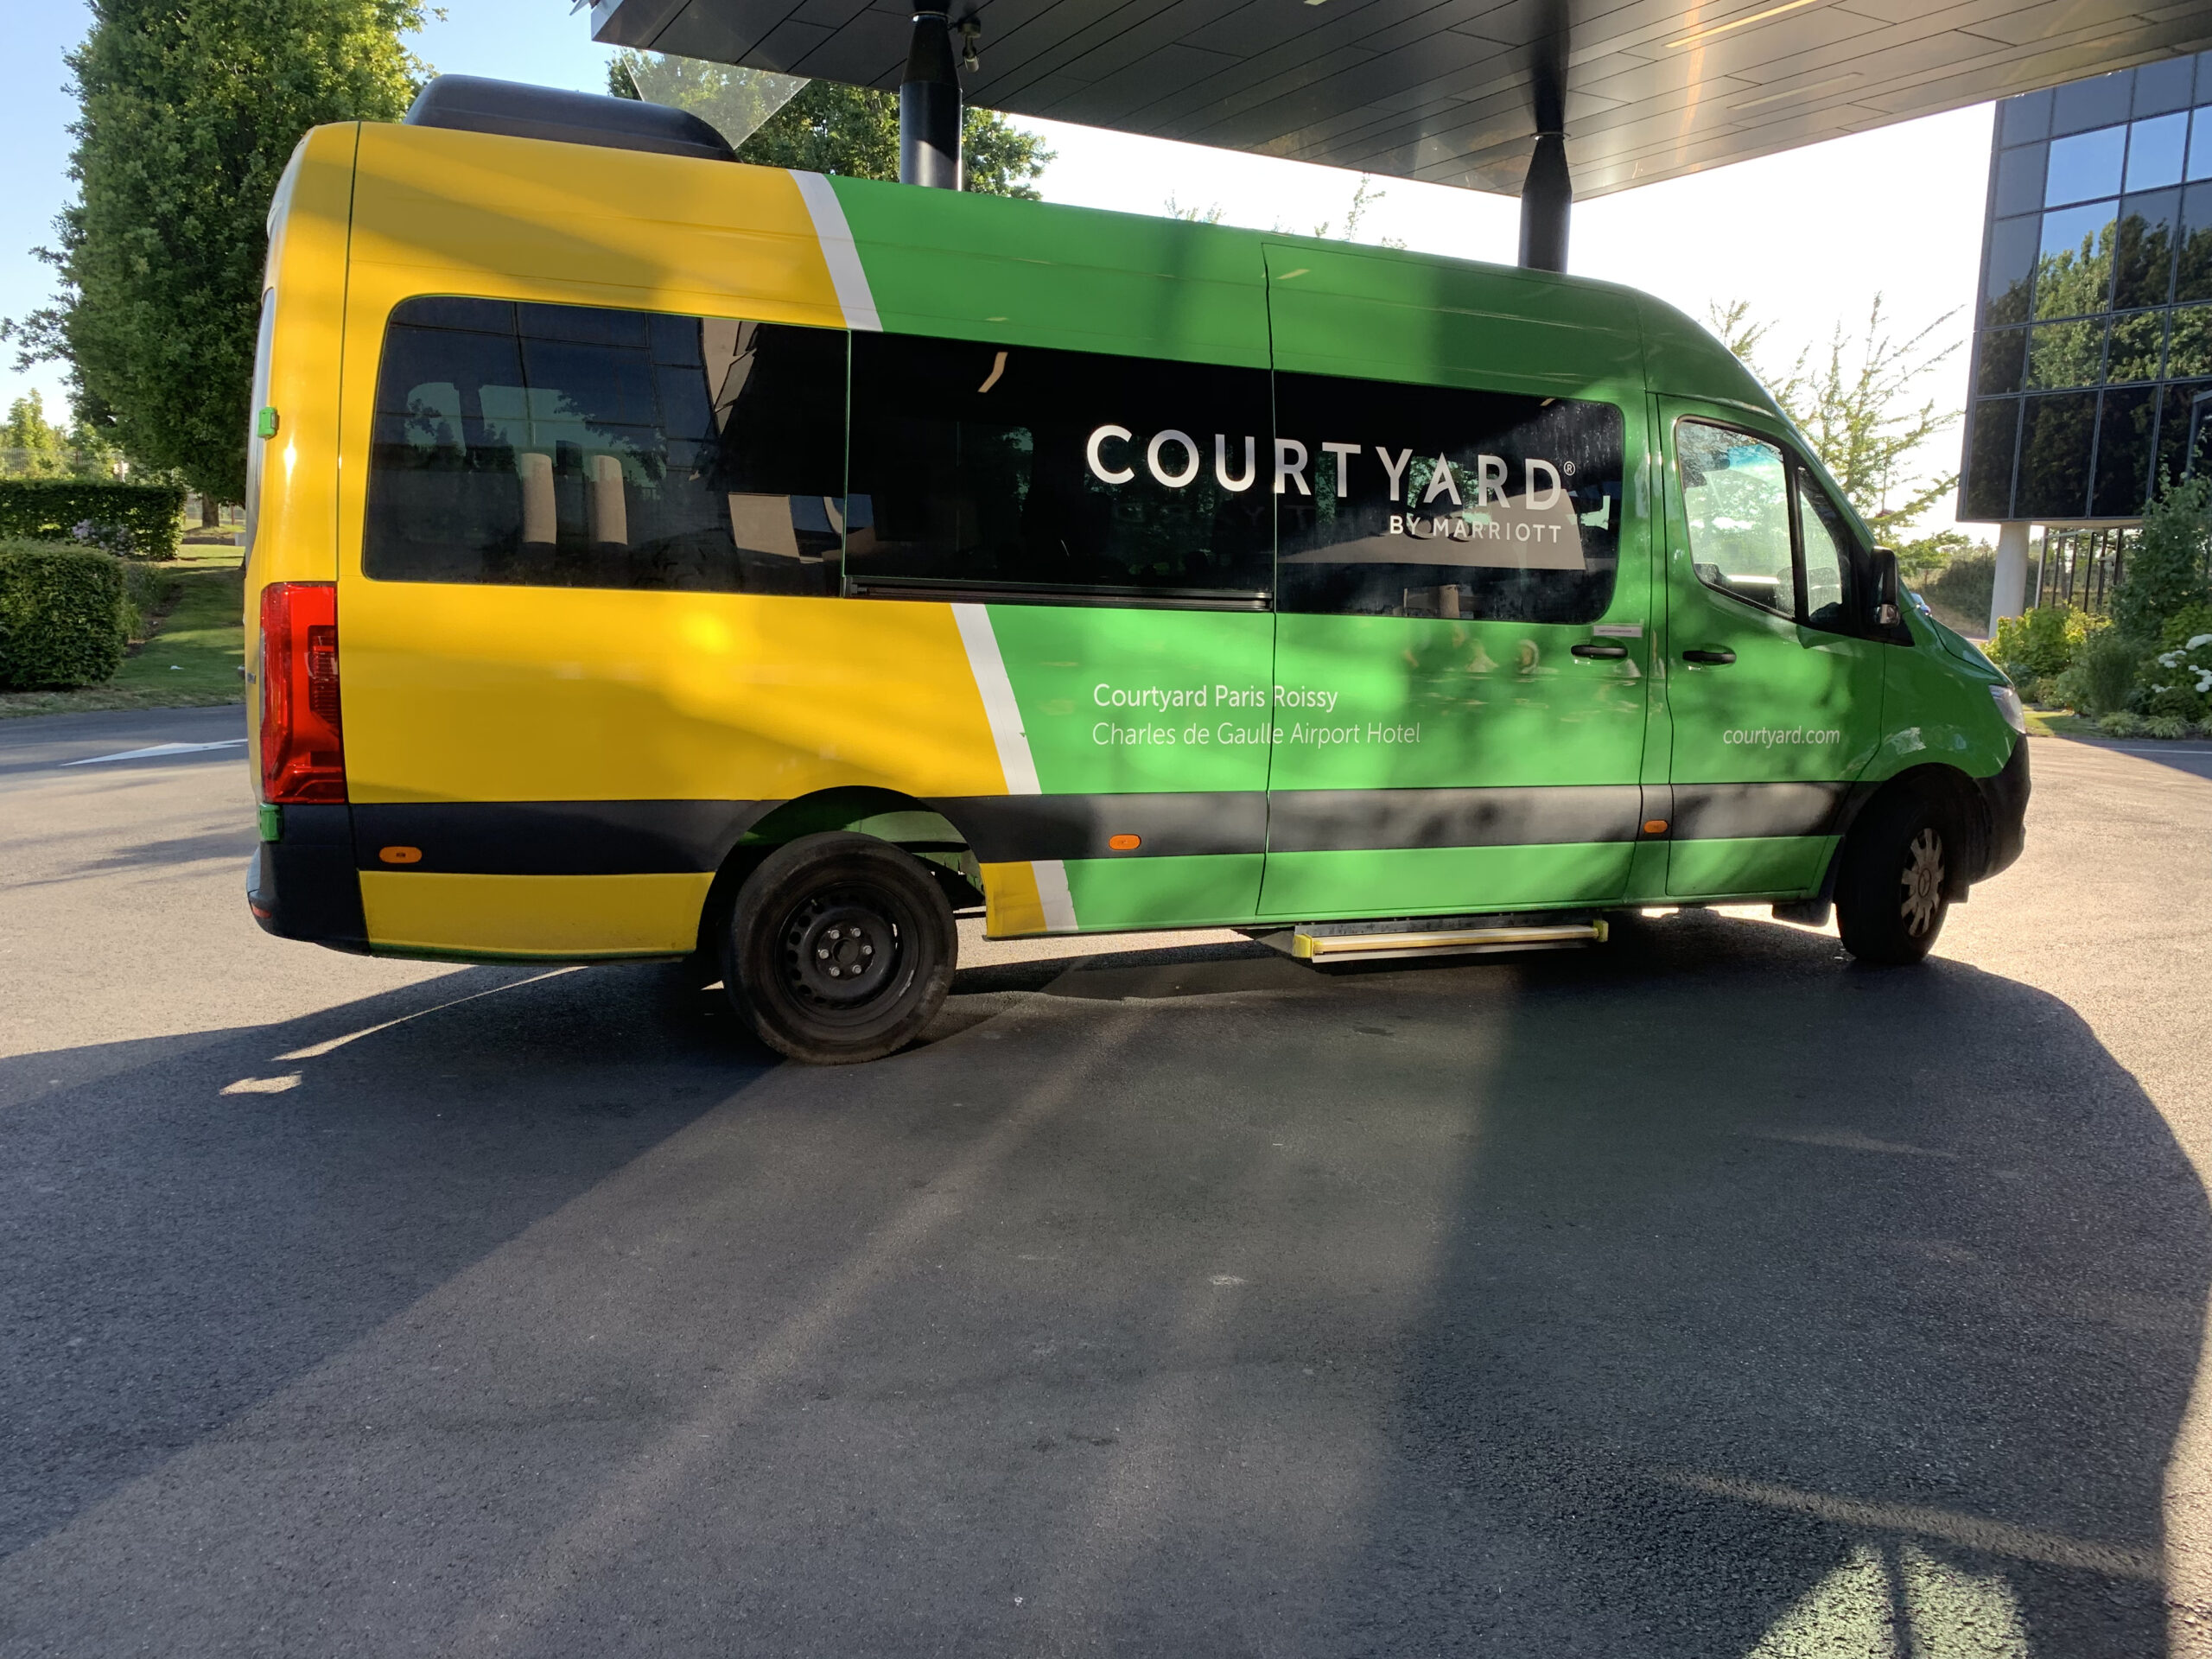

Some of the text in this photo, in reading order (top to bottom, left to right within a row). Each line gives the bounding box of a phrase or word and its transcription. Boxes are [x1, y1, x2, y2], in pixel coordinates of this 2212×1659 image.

[1389, 515, 1562, 543] BY MARRIOTT
[1093, 683, 1338, 712] Courtyard Paris Roissy
[1092, 721, 1421, 749] Charles de Gaulle Airport Hotel
[1723, 726, 1840, 748] courtyard.com
